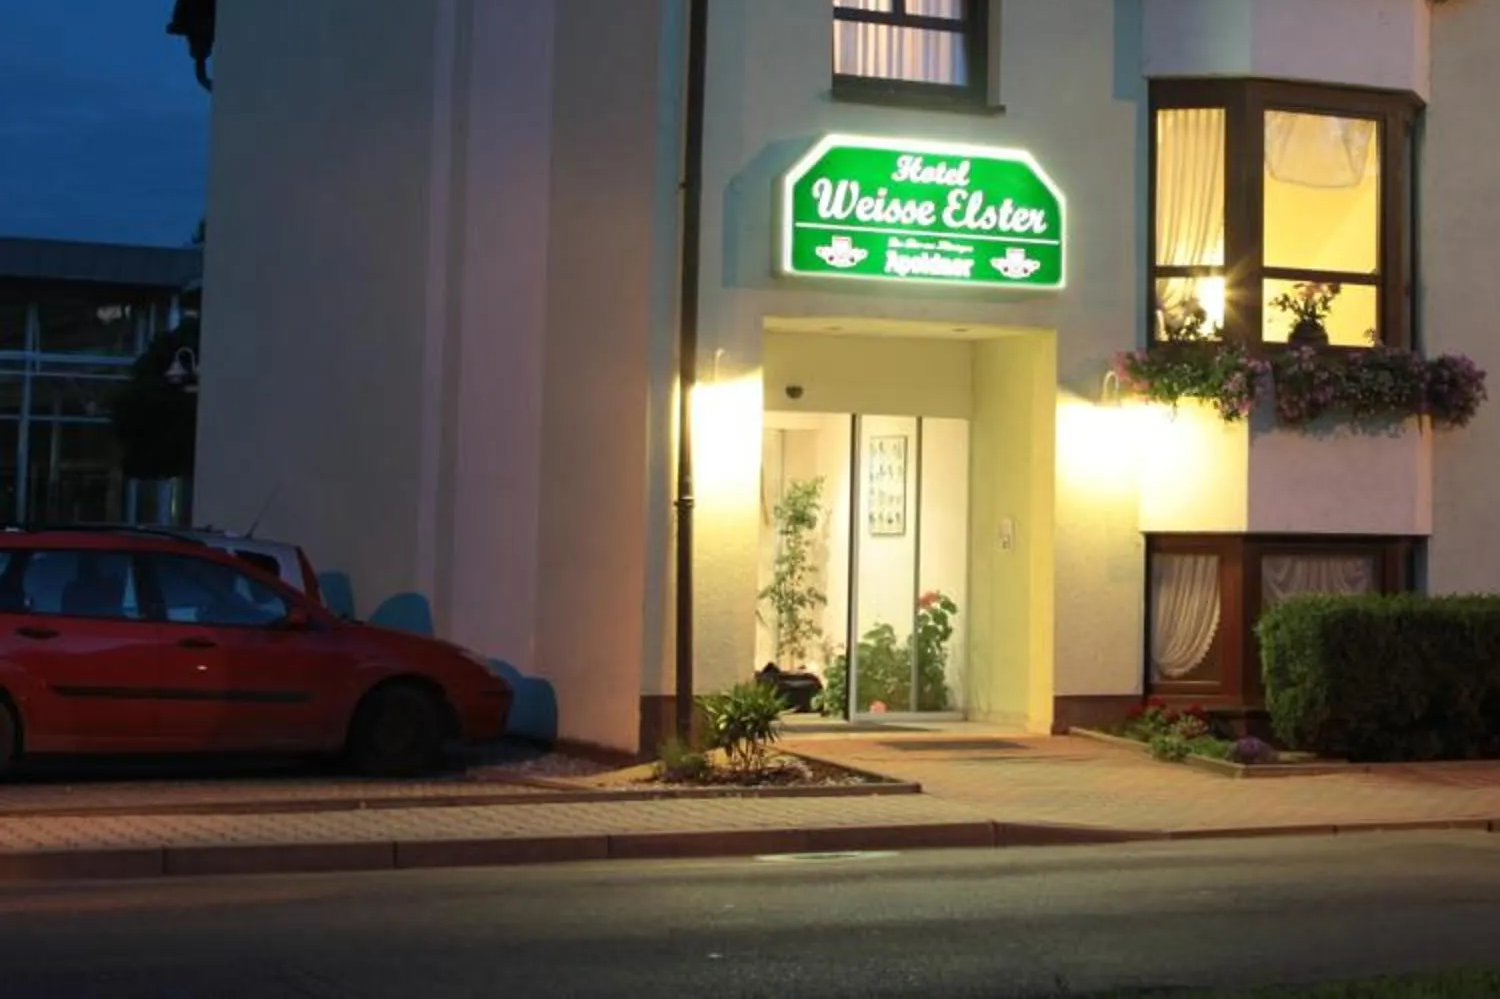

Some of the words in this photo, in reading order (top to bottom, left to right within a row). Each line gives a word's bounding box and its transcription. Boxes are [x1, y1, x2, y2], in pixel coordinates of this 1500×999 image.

[892, 155, 971, 186] Hotel
[812, 178, 937, 226] Weisse
[942, 188, 1047, 233] Elster
